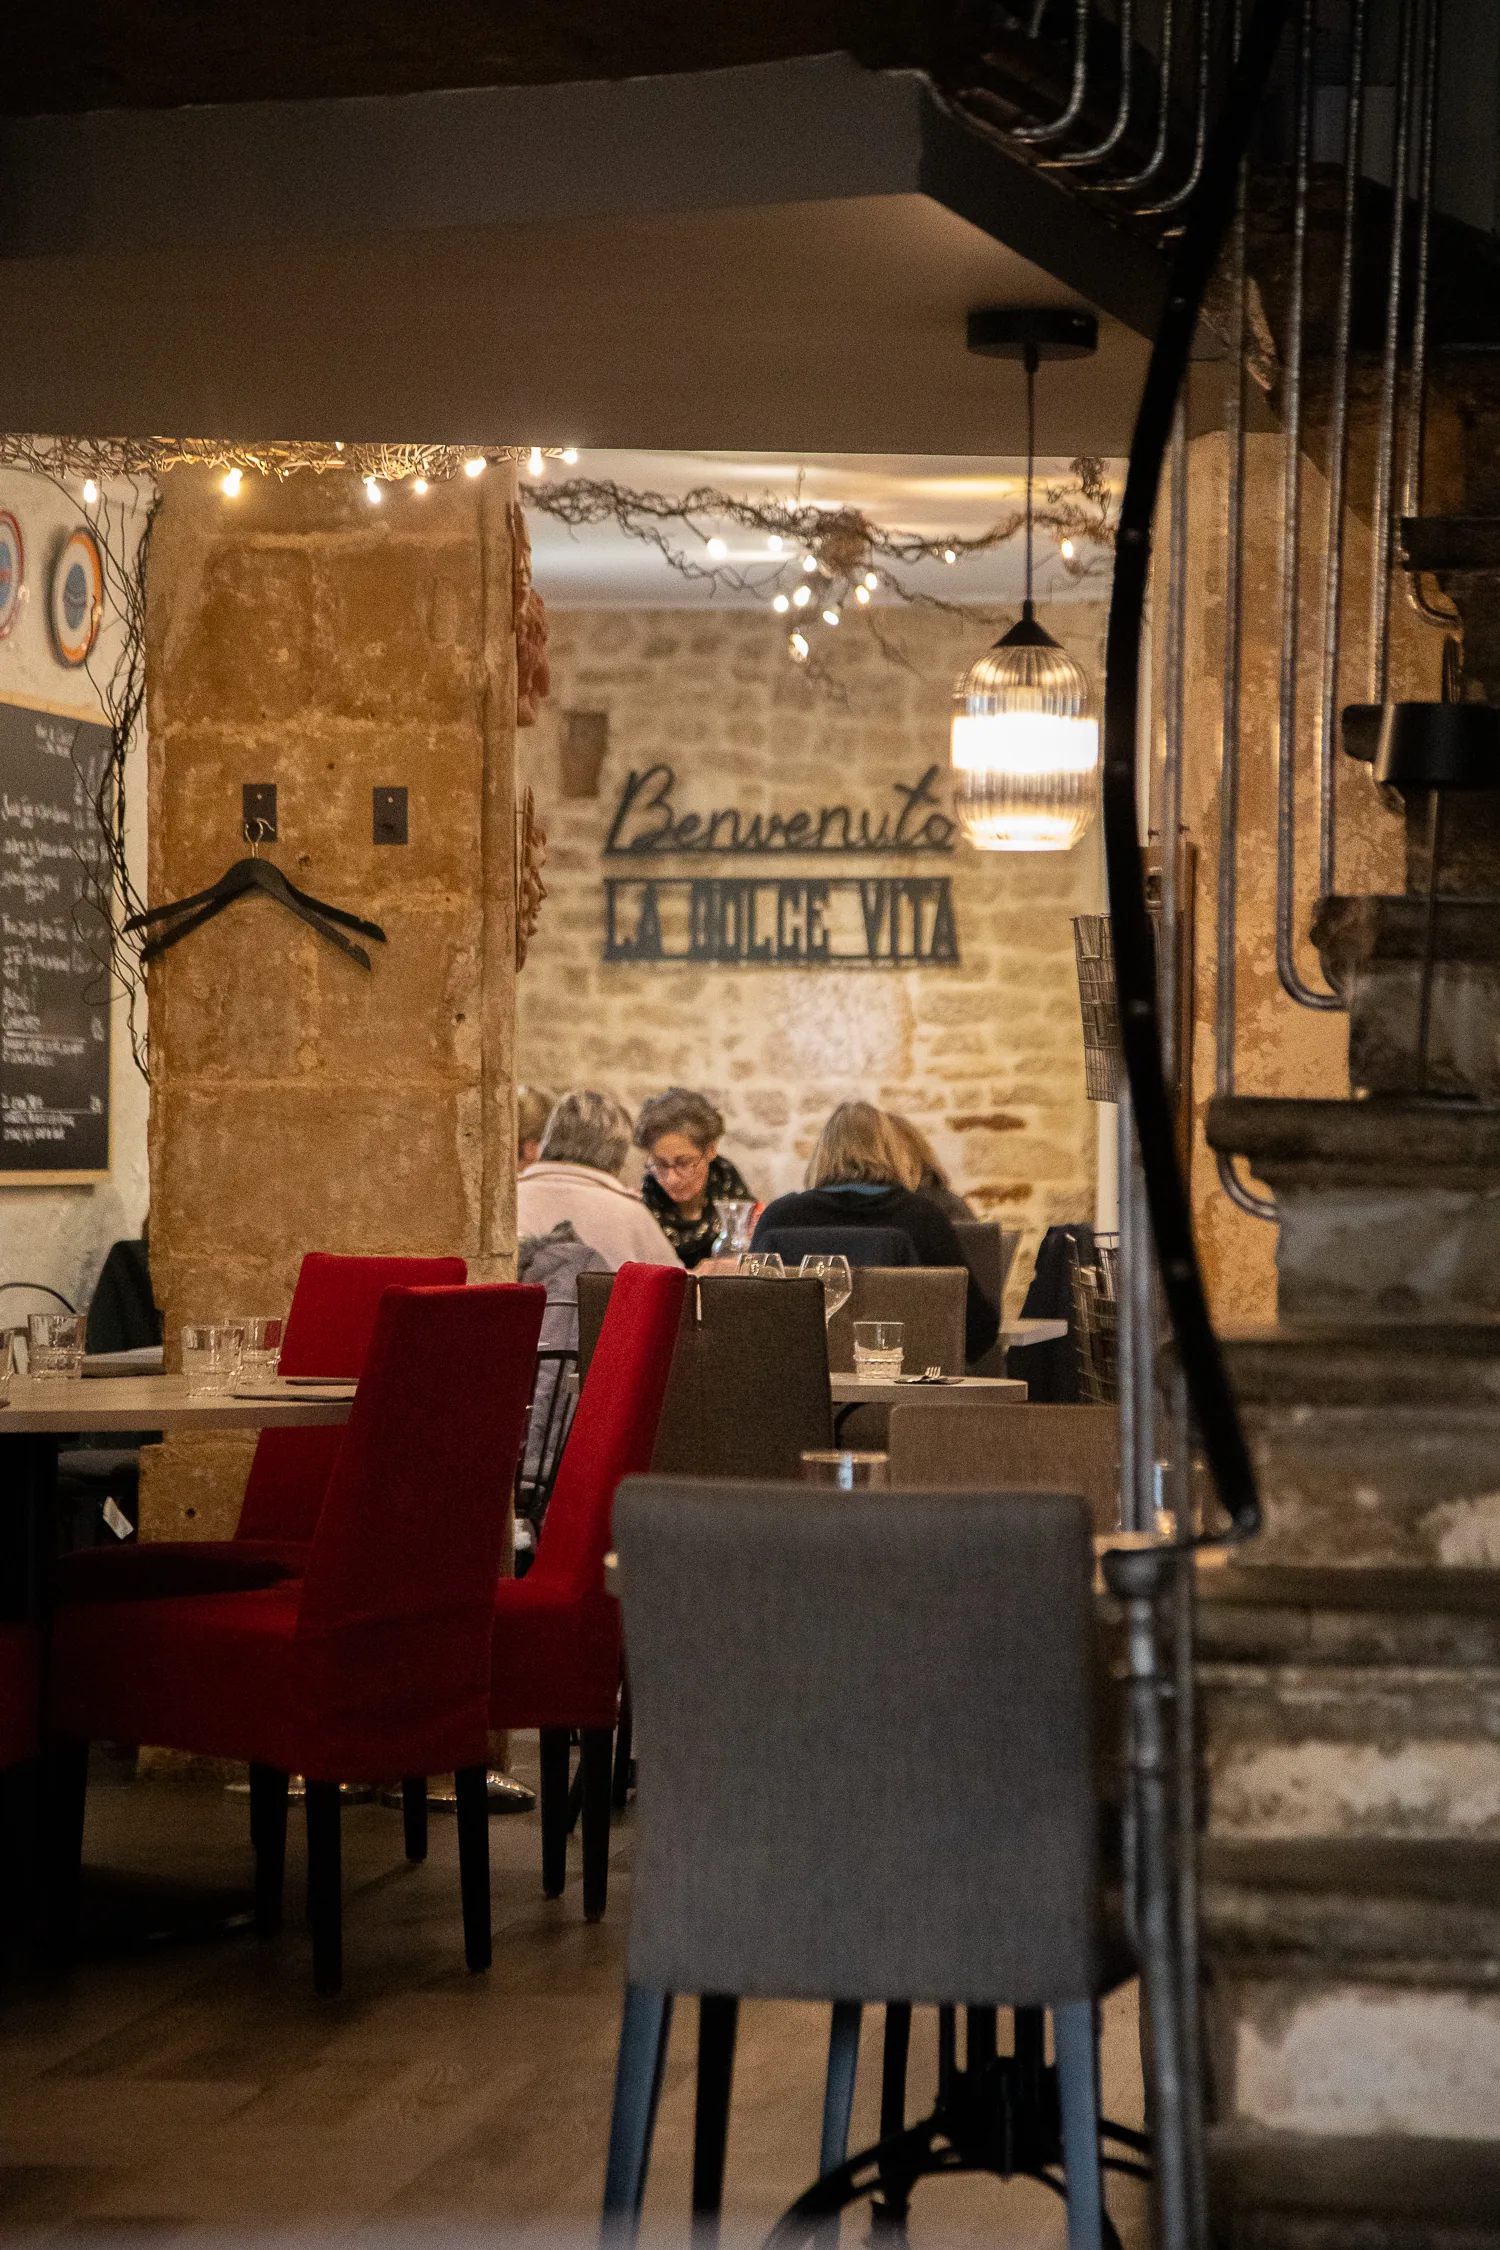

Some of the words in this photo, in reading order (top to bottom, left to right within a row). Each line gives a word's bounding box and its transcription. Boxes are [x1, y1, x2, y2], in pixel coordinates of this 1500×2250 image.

[604, 764, 956, 855] Benvenuto
[604, 878, 664, 962] LA
[858, 877, 960, 964] VITA
